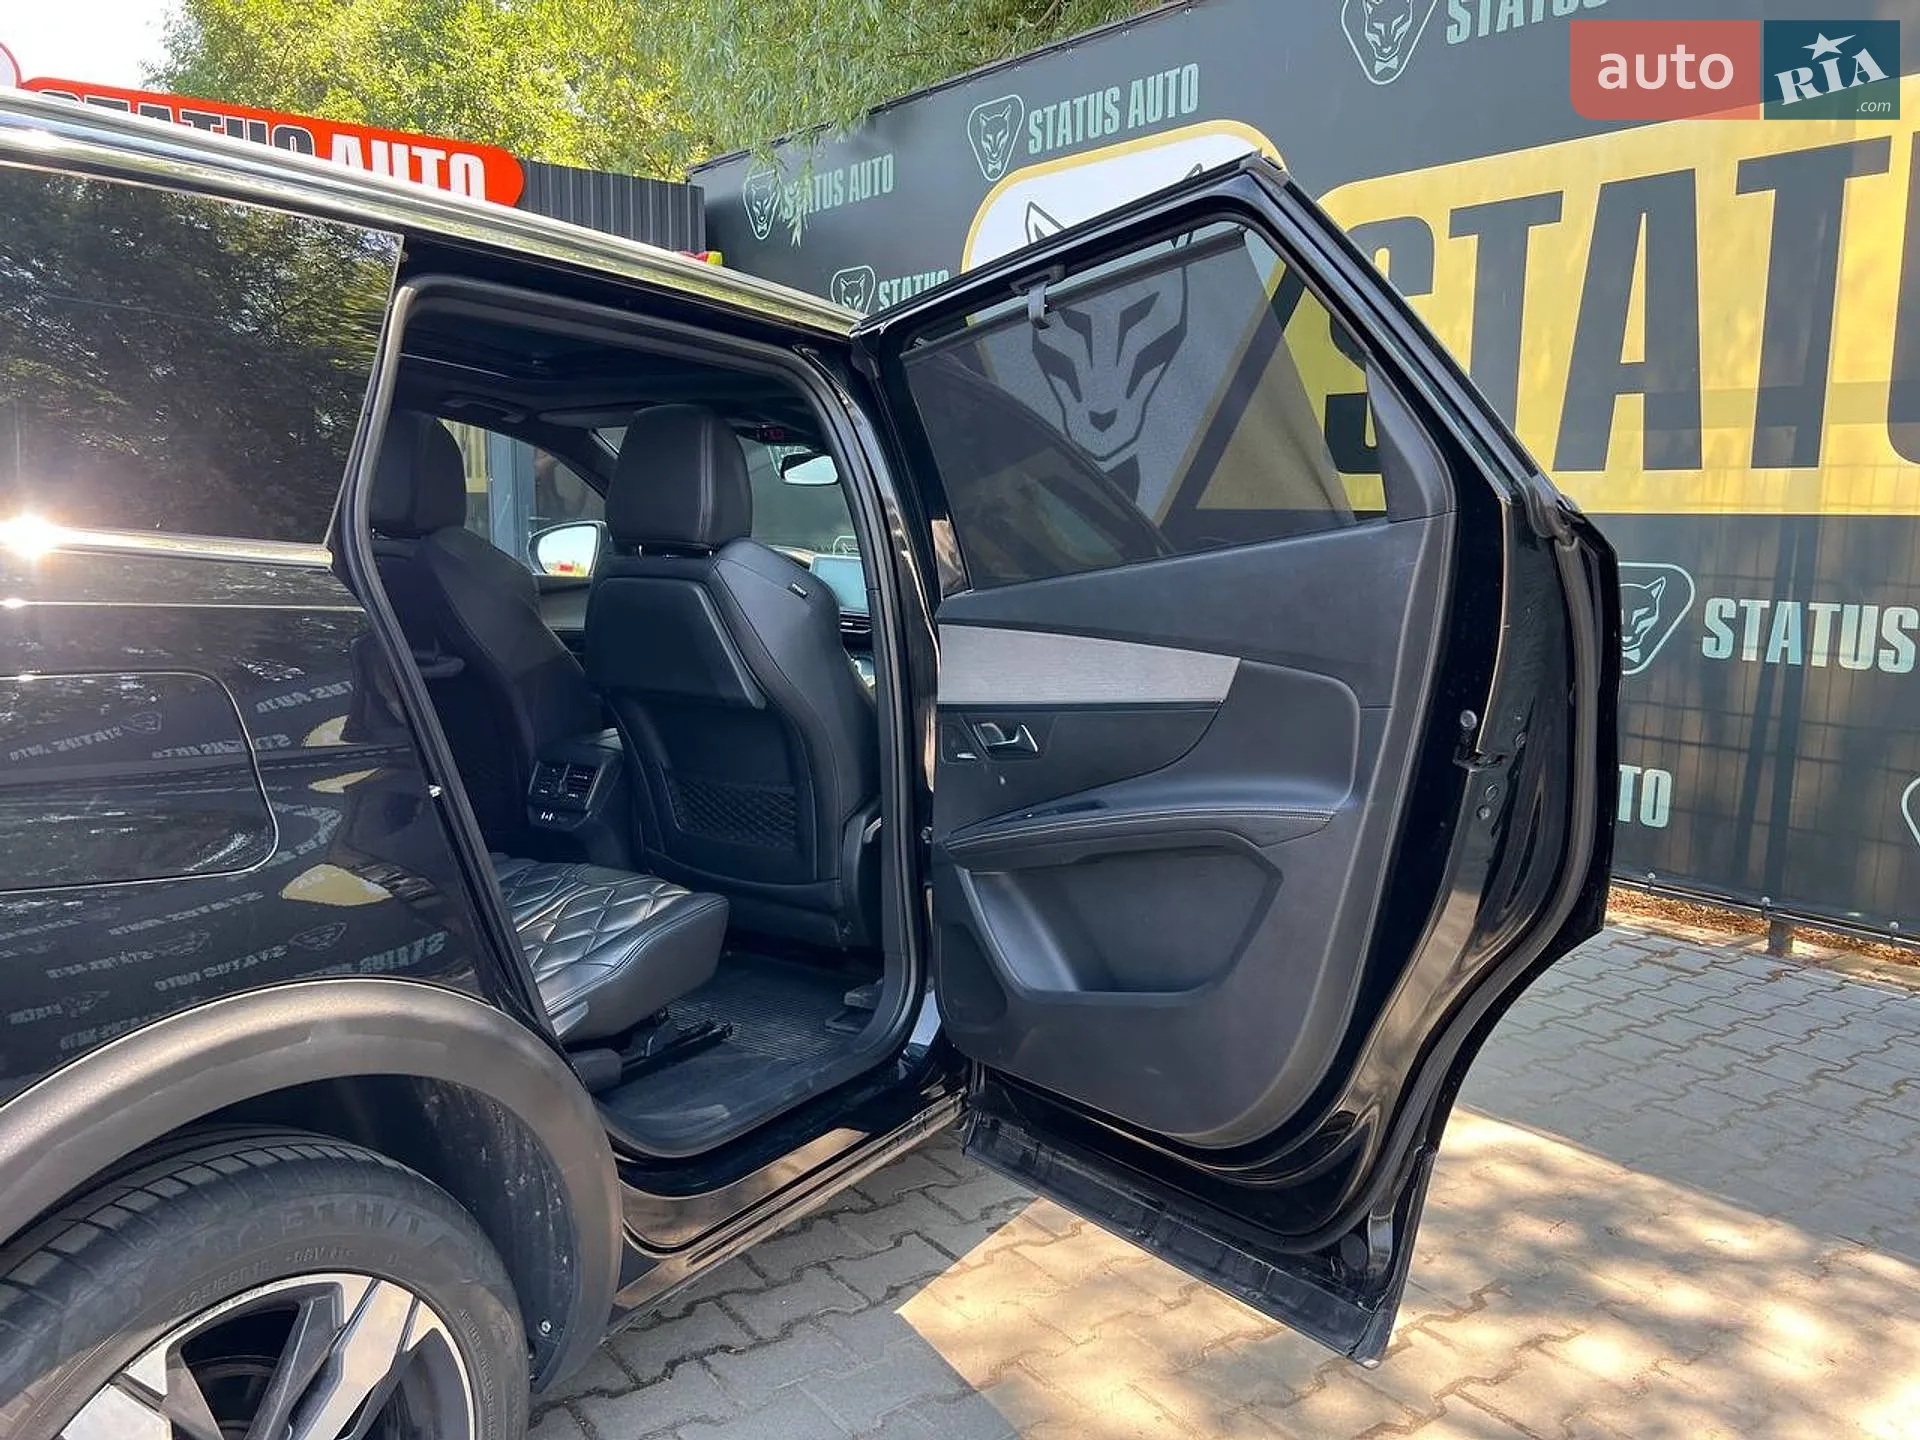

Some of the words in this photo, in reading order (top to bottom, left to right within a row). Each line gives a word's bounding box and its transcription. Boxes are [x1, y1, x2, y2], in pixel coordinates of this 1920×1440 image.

[1028, 86, 1121, 154] STATUS
[1128, 63, 1199, 129] AUTO
[850, 153, 894, 203] AUTO
[1702, 597, 1920, 674] STATUS
